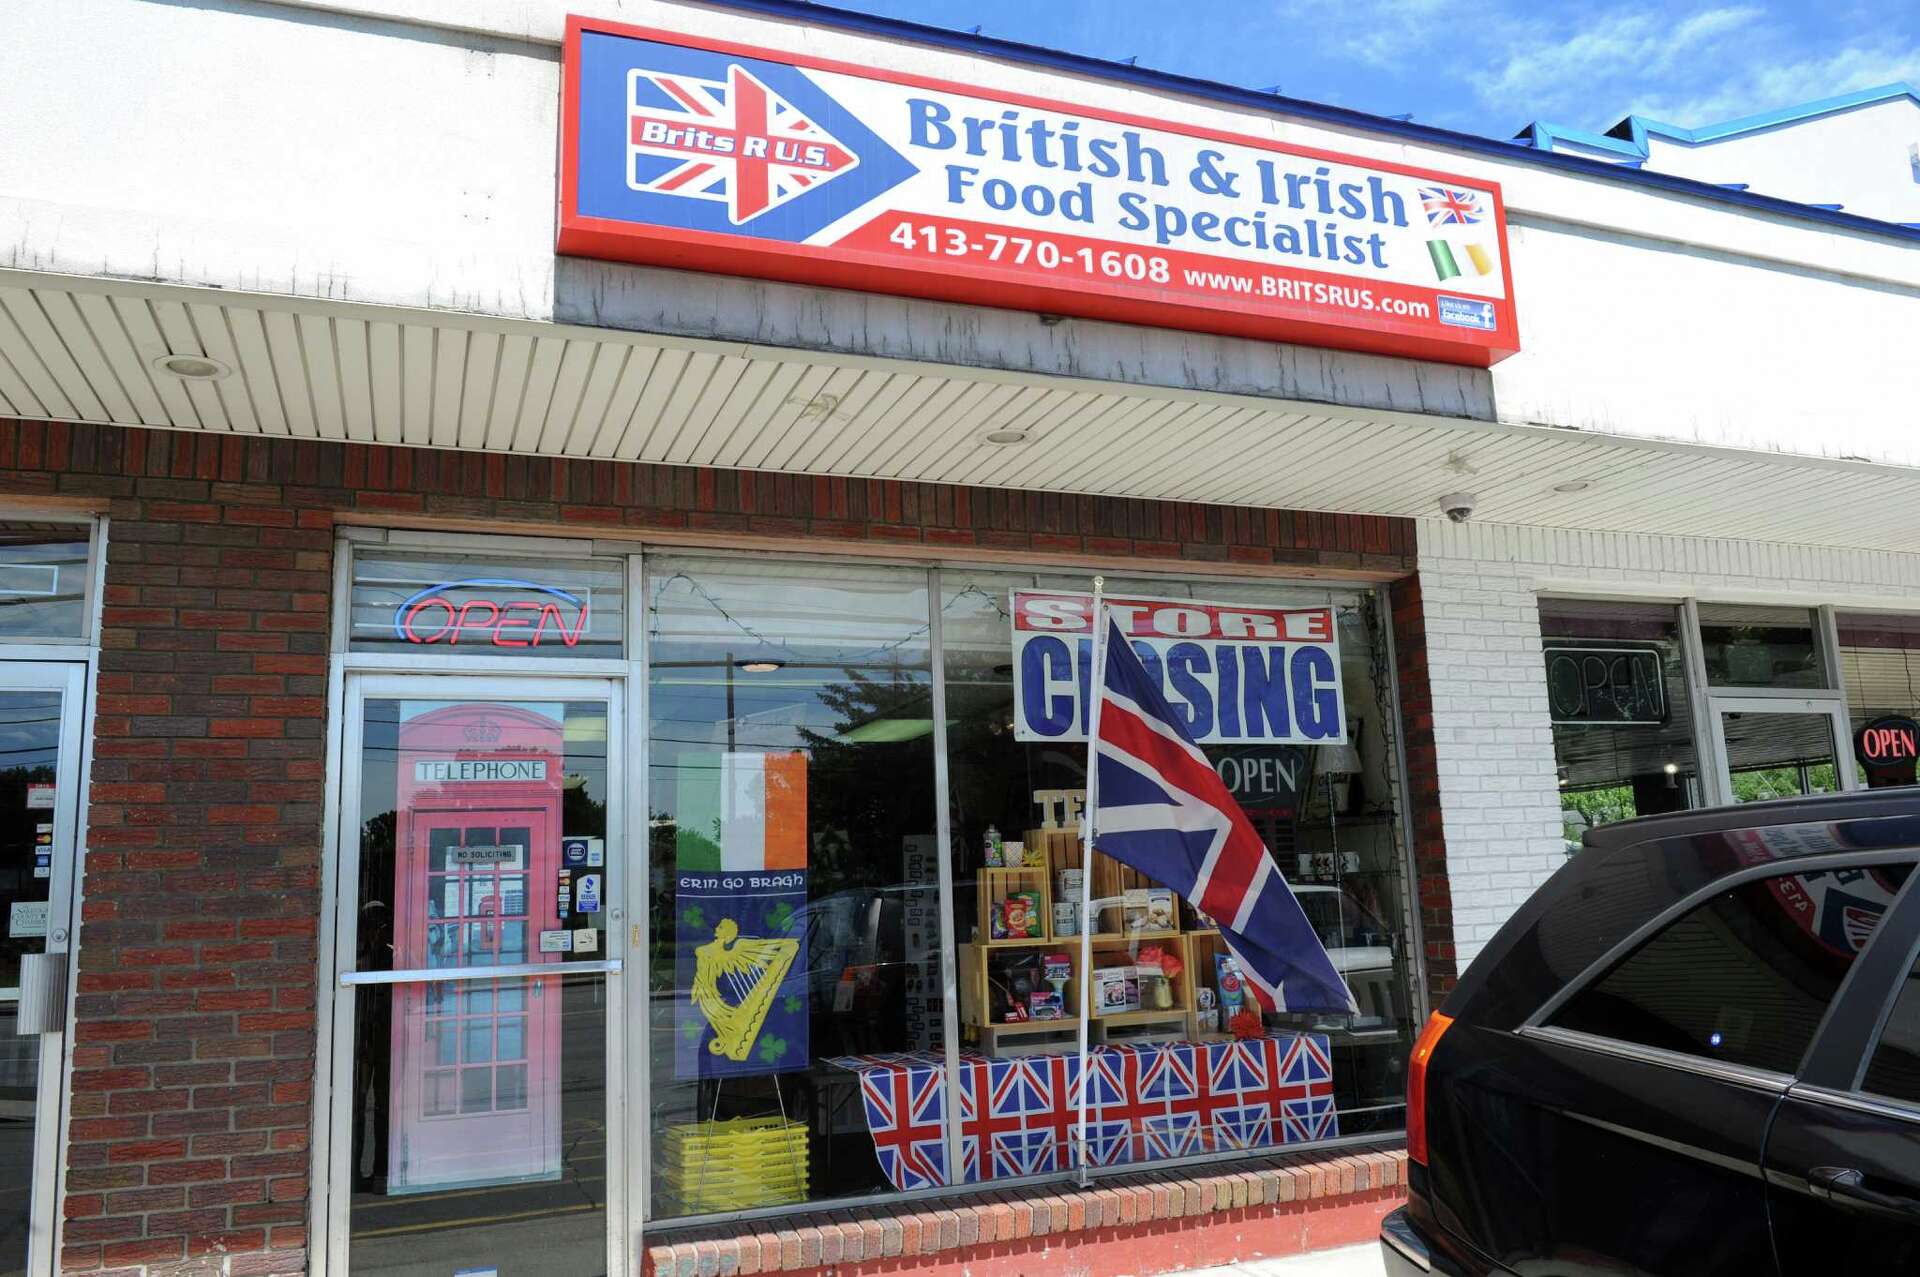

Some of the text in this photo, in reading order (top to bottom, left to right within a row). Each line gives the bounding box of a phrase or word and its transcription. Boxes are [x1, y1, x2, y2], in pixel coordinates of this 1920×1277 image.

[641, 121, 831, 168] Brits R U.S.
[905, 98, 1409, 228] British & Irish
[945, 164, 1389, 268] Food Specialist
[889, 221, 1430, 319] 413-770-1608 www.BRITSRUS.com
[404, 596, 588, 648] OPEN
[1024, 600, 1327, 640] STORE
[1551, 655, 1660, 717] OPEN
[1863, 728, 1916, 758] OPEN
[420, 761, 544, 781] TELEPHONE
[1216, 756, 1297, 793] OPEN
[457, 850, 512, 859] NO SOLICITING
[680, 877, 718, 889] ERIN
[722, 877, 744, 890] GO
